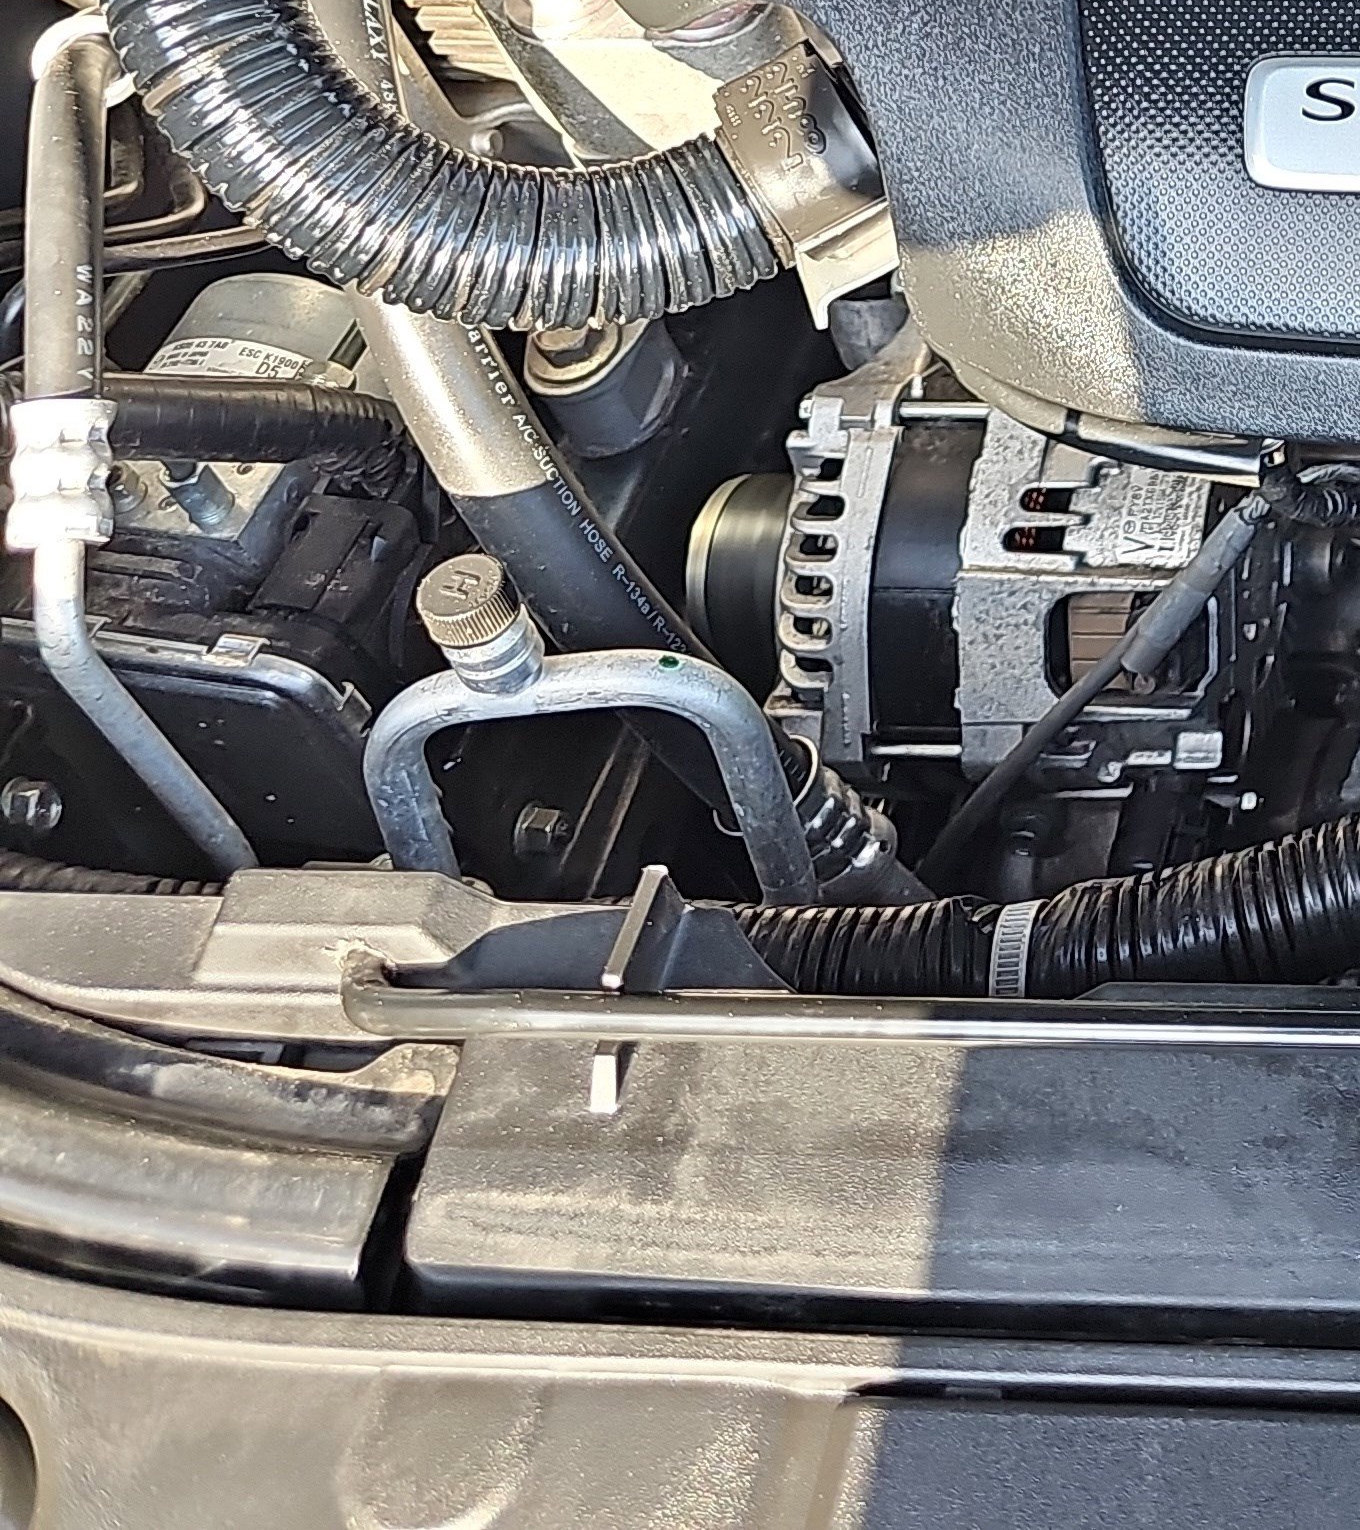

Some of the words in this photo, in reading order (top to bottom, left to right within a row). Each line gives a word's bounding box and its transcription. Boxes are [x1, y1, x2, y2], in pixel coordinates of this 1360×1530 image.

[238, 346, 262, 360] ESC
[263, 353, 300, 370] K1900
[255, 361, 280, 379] D5
[467, 323, 516, 406] arrier
[512, 413, 538, 444] A/C
[578, 518, 614, 563] HOSE
